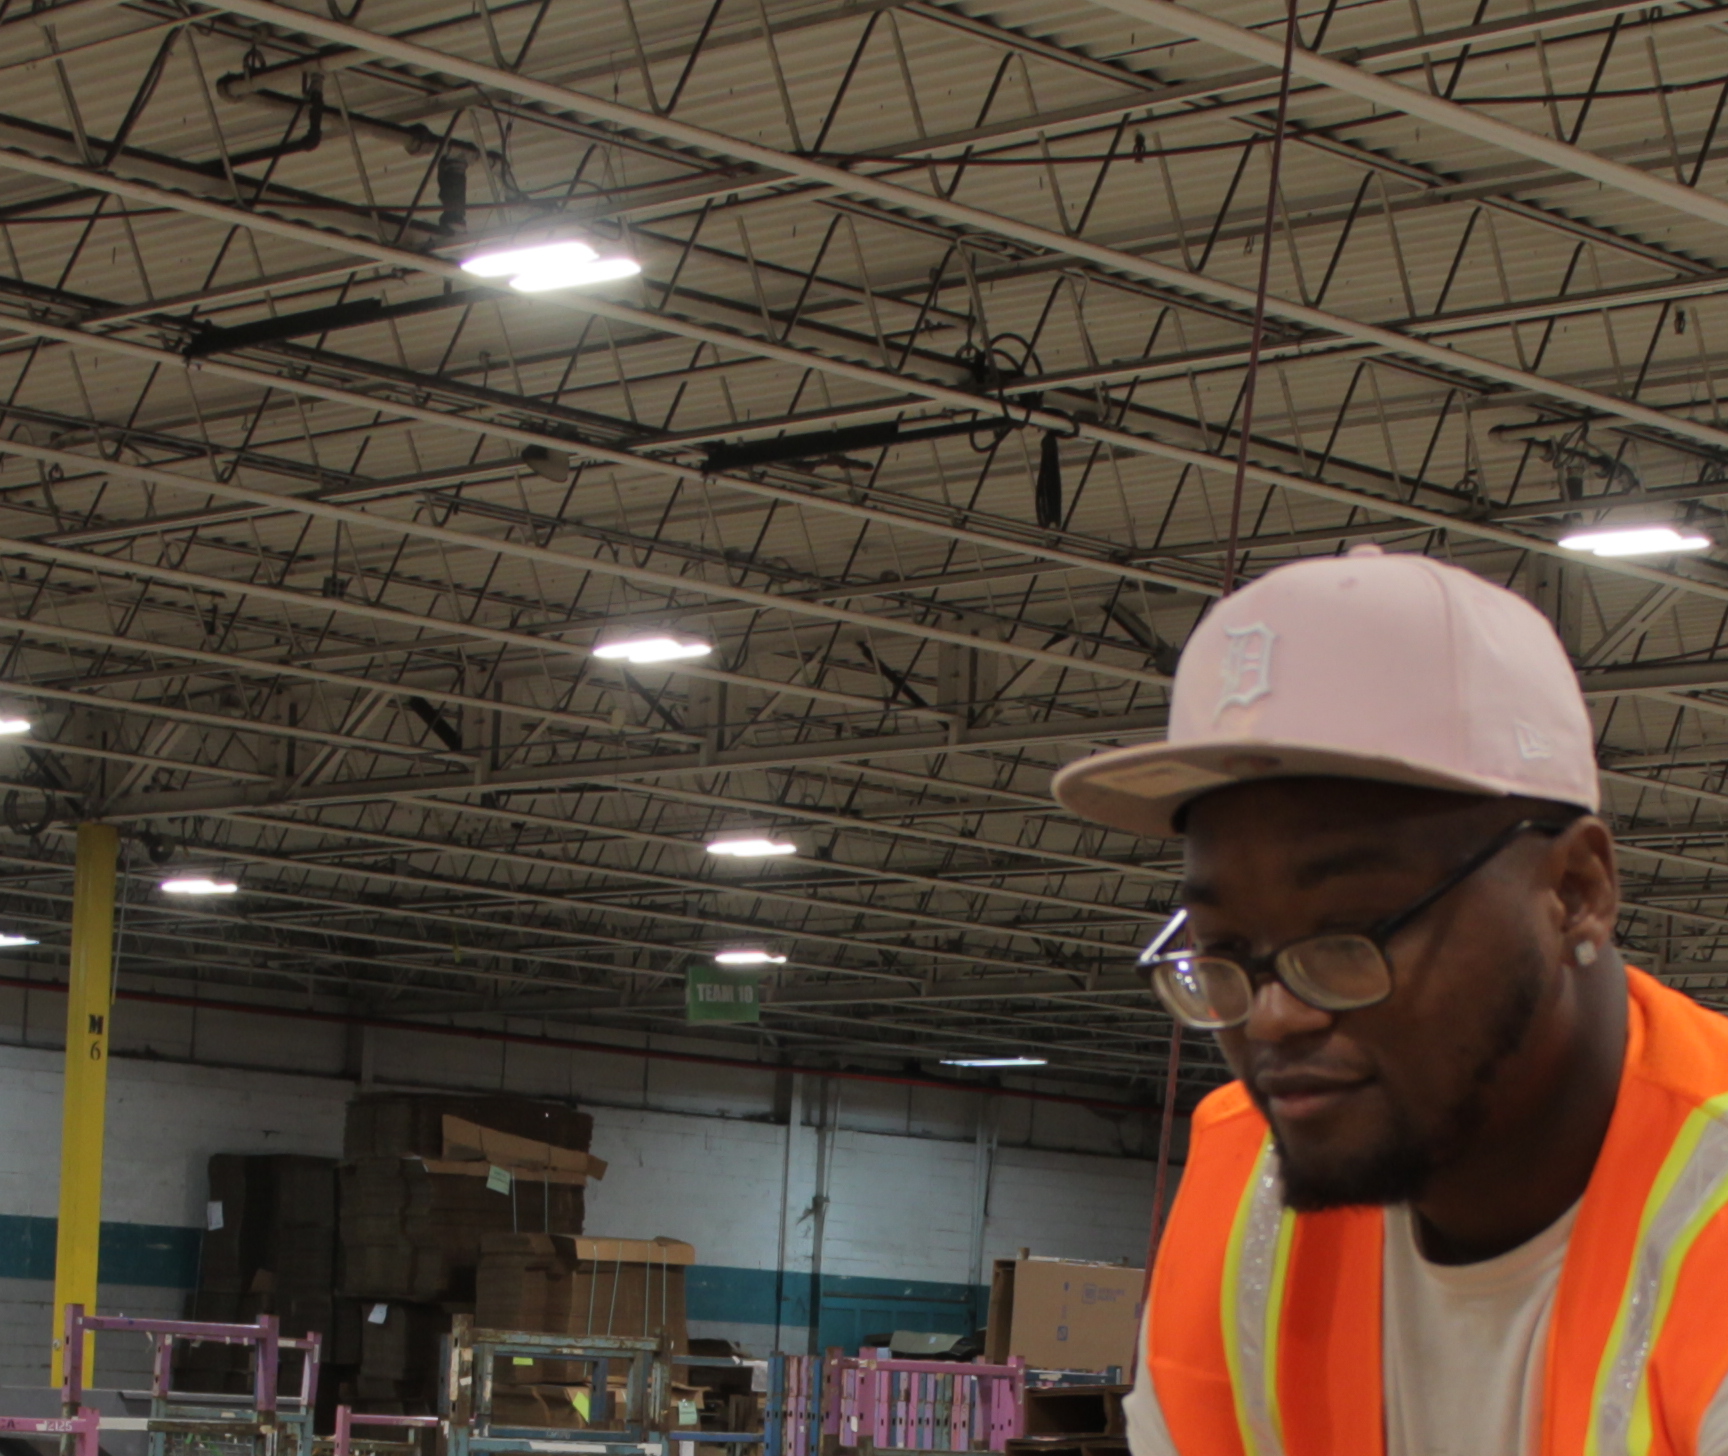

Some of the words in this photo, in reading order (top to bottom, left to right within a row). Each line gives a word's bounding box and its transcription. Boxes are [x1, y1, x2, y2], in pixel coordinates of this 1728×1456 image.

[1213, 620, 1281, 724] D
[696, 984, 734, 1003] TEAM
[737, 985, 754, 1003] 10
[88, 1014, 104, 1035] M
[90, 1041, 102, 1061] 6
